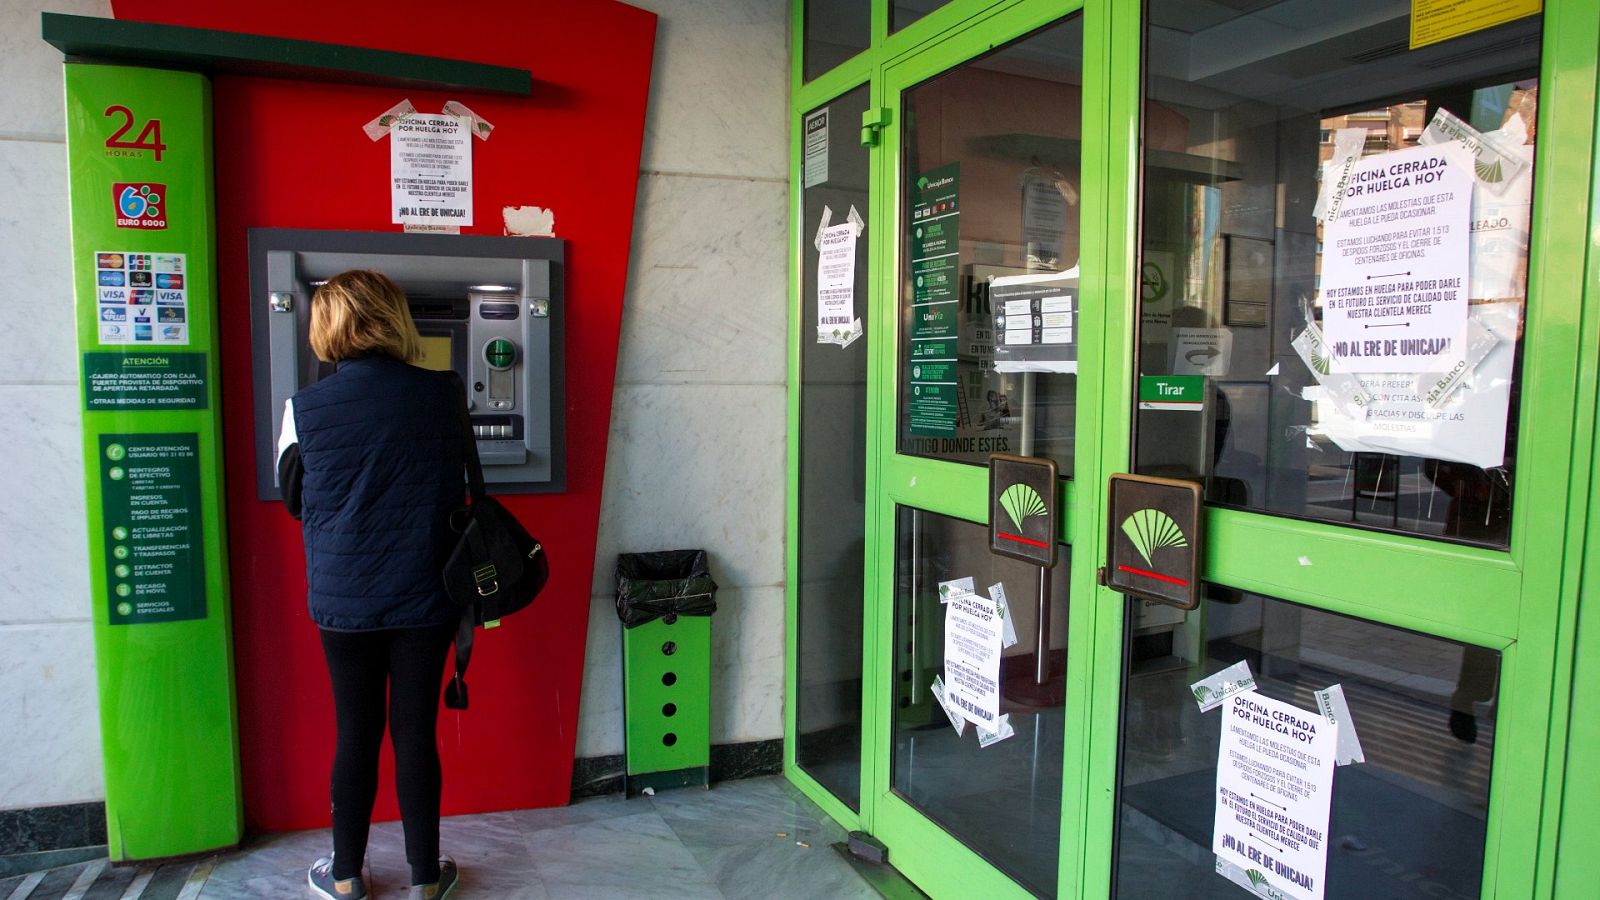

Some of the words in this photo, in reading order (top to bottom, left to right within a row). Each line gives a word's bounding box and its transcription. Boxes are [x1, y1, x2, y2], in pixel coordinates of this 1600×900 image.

[104, 105, 166, 161] 24
[1450, 127, 1483, 157] Unicaja
[1337, 157, 1353, 188] Banco
[1390, 157, 1447, 175] CERRADA
[1367, 177, 1410, 194] HUELGA
[1415, 170, 1444, 185] HOY
[1376, 203, 1387, 212] LAS
[1388, 198, 1421, 212] MOLESTIAS
[1422, 196, 1435, 205] QUE
[1436, 192, 1454, 202] ESTA
[411, 208, 418, 216] AL
[420, 208, 429, 216] ERE
[440, 209, 465, 218] UNICAJA!
[1349, 216, 1372, 227] HUELGA
[1373, 216, 1379, 224] LE
[1381, 212, 1399, 223] PUEDA
[1337, 237, 1363, 248] ESTAMOS
[1364, 233, 1392, 244] LUCHANDO
[1393, 231, 1408, 239] PARA
[1409, 227, 1430, 237] EVITAR
[1342, 245, 1368, 256] DESPIDOS
[1369, 243, 1397, 254] FORZOSOS
[1411, 238, 1432, 247] CIERRE
[1433, 237, 1441, 245] DE
[1355, 254, 1389, 265] CENTENARES
[1391, 252, 1398, 261] DE
[1326, 289, 1337, 298] HOY
[1338, 287, 1364, 296] ESTAMOS
[1365, 286, 1373, 295] EN
[1373, 284, 1396, 294] HUELGA
[1397, 282, 1414, 291] PARA
[1415, 280, 1437, 290] PODER
[1439, 278, 1461, 289] DARLE
[1329, 300, 1336, 309] EN
[1338, 299, 1344, 308] EL
[1345, 297, 1367, 308] FUTURO
[1368, 296, 1374, 306] EL
[1376, 294, 1402, 305] SERVICIO
[1403, 294, 1412, 303] DE
[1413, 292, 1442, 303] CALIDAD
[1443, 291, 1457, 301] QUE
[1347, 308, 1373, 319] NUESTRA
[1373, 306, 1404, 317] CLIENTELA
[1406, 305, 1432, 315] MERECE
[976, 331, 983, 339] EN
[971, 345, 978, 353] EN
[1350, 341, 1362, 356] AL
[1364, 341, 1381, 356] ERE
[1384, 340, 1397, 356] DE
[122, 357, 169, 365] ATENCIÓN
[1437, 359, 1466, 389] Banco
[1156, 383, 1185, 395] Tirar
[1449, 413, 1464, 421] LAS
[942, 437, 976, 453] DONDE
[978, 435, 1010, 452] ESTÉS.
[1212, 684, 1238, 699] Unicaja
[1235, 697, 1269, 717] OFICINA
[1272, 710, 1316, 734] CERRADA
[1322, 693, 1336, 725] Banco
[1233, 707, 1250, 721] POR
[1253, 715, 1289, 735] HUELGA
[1292, 728, 1314, 744] HOY
[1222, 796, 1227, 805] EN
[1235, 802, 1251, 817] FUTURO
[1252, 811, 1257, 821] EL
[1258, 814, 1278, 830] SERVICIO
[1279, 825, 1286, 835] DE
[1286, 828, 1307, 844] CALIDAD
[1309, 839, 1319, 850] QUE
[1249, 801, 1255, 809] EN
[1256, 804, 1273, 818] HUELGA
[1275, 813, 1288, 825] PARA
[1289, 816, 1305, 833] PODER
[1305, 826, 1322, 841] DARLE
[1236, 813, 1256, 828] NUESTRA
[1256, 824, 1279, 840] CLIENTELA
[1280, 835, 1300, 851] MERECE
[1222, 833, 1235, 850] ¡NO
[1237, 840, 1246, 857] AL
[1248, 846, 1262, 865] ERE
[1263, 853, 1274, 871] DE
[1275, 859, 1313, 891] UNICAJA!
